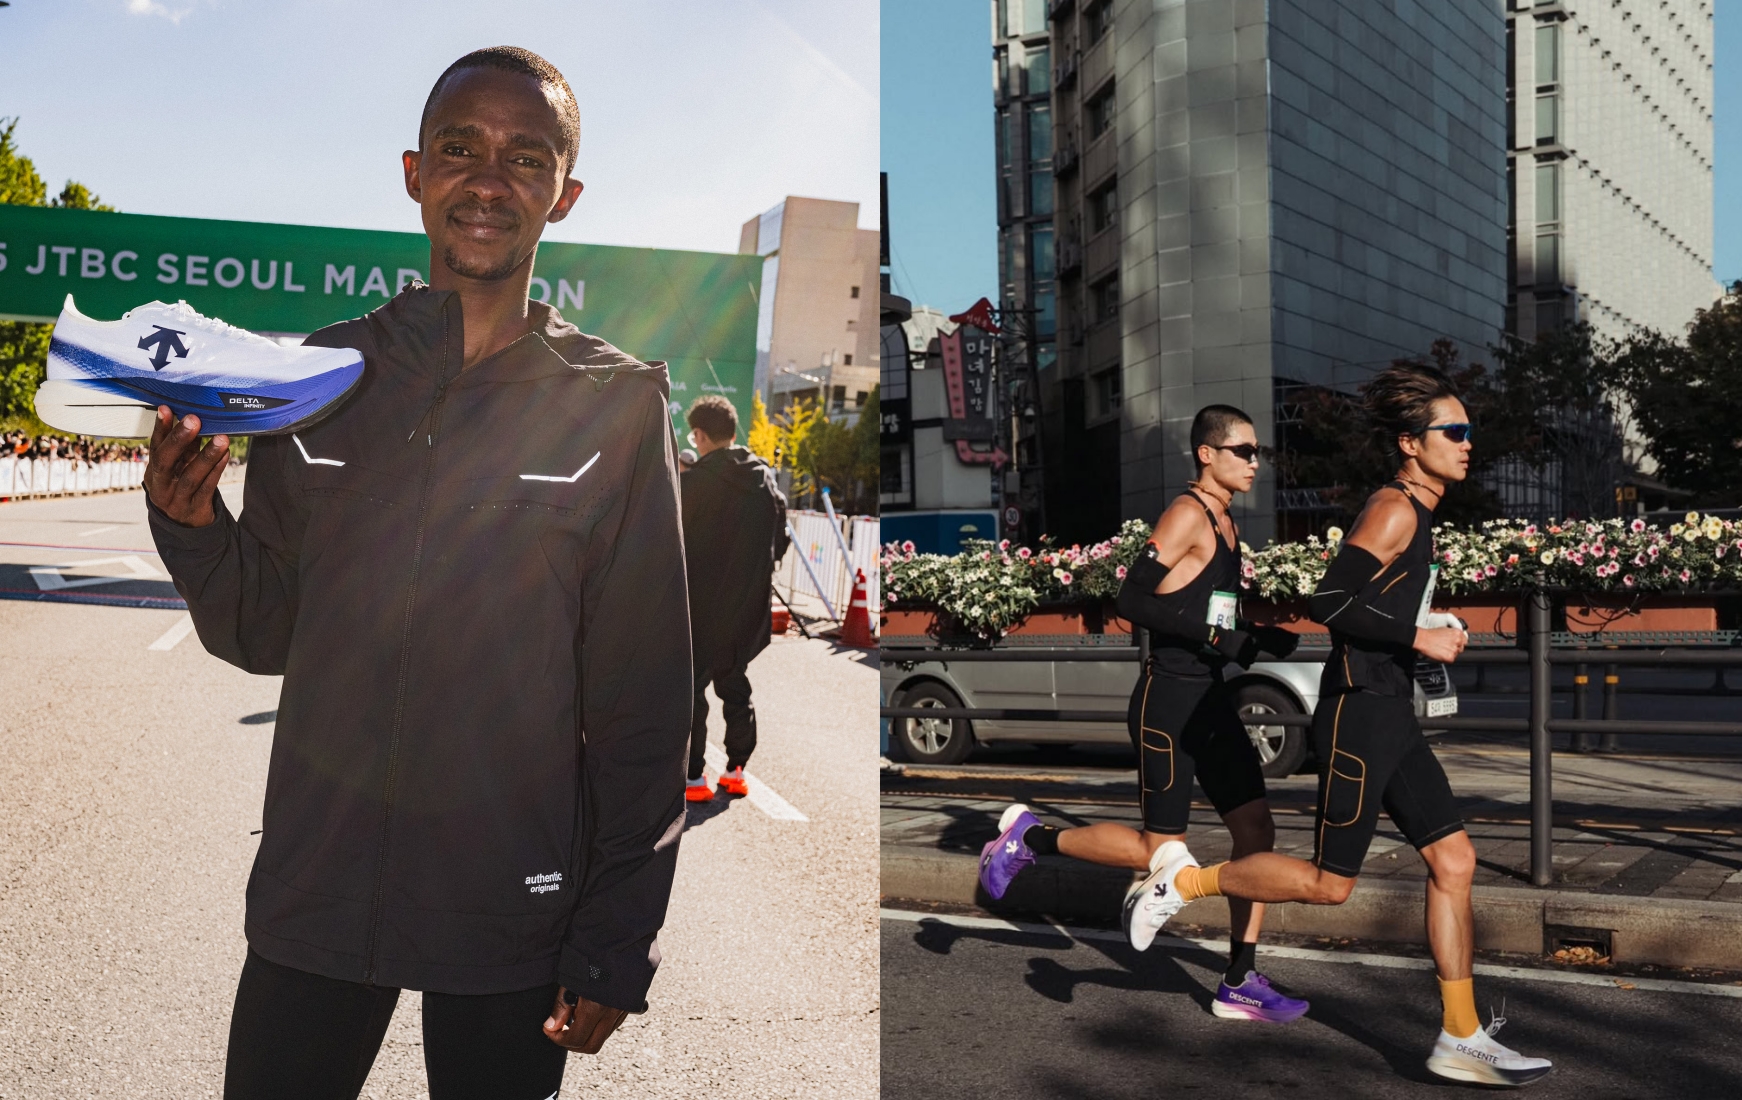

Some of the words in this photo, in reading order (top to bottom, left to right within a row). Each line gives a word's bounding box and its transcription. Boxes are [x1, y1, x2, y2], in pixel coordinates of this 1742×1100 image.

[25, 245, 139, 281] JTBC
[156, 253, 305, 292] SEOUL
[965, 338, 990, 412] 마녀김밥
[1007, 508, 1018, 523] 30
[525, 871, 562, 884] authentic
[531, 883, 559, 894] originals
[1228, 991, 1263, 1008] DESCENTE
[1456, 1043, 1499, 1065] DESCENTE
